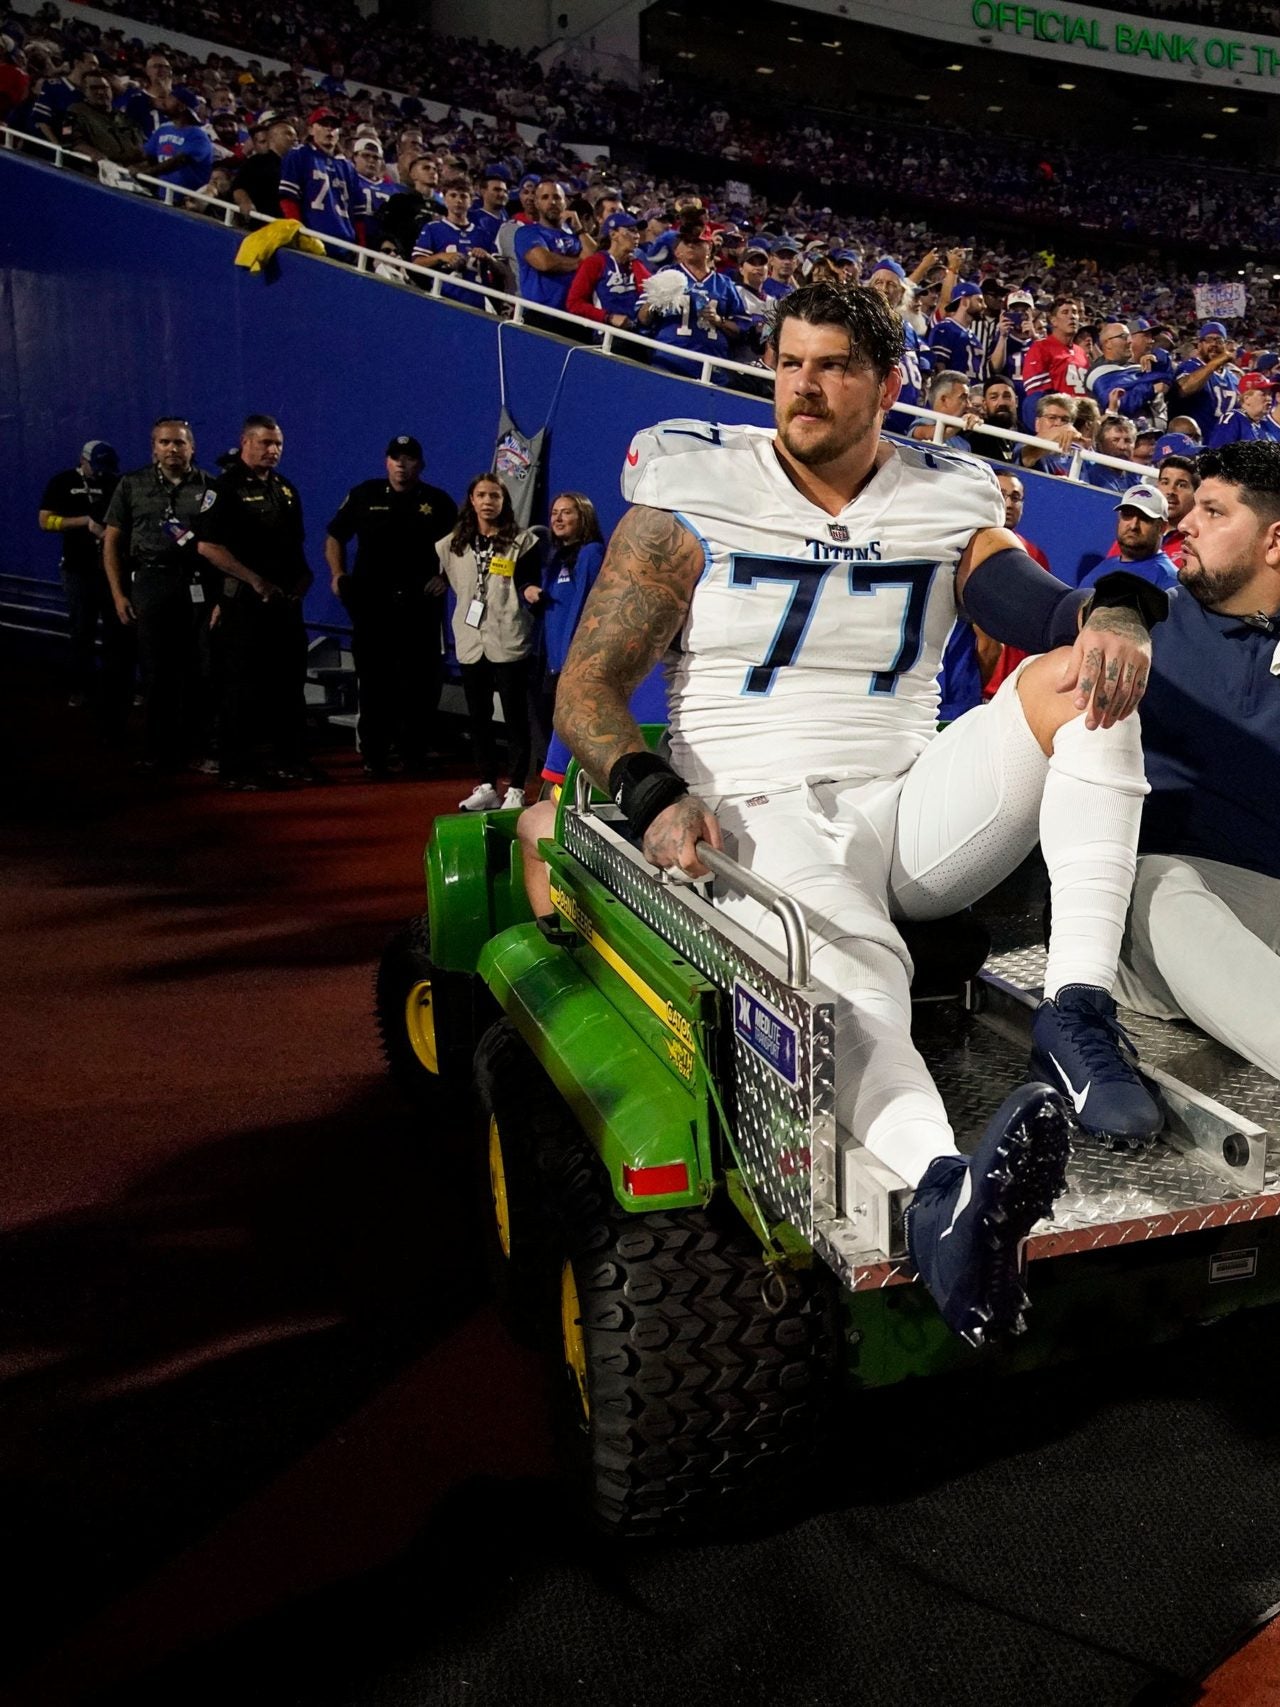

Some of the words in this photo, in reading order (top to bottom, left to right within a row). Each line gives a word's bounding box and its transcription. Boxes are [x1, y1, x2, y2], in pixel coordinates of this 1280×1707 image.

[971, 0, 1108, 50] OFFICIAL
[1115, 23, 1199, 65] BANK
[1204, 38, 1245, 70] OF
[1213, 385, 1237, 418] 17
[728, 551, 941, 697] 77
